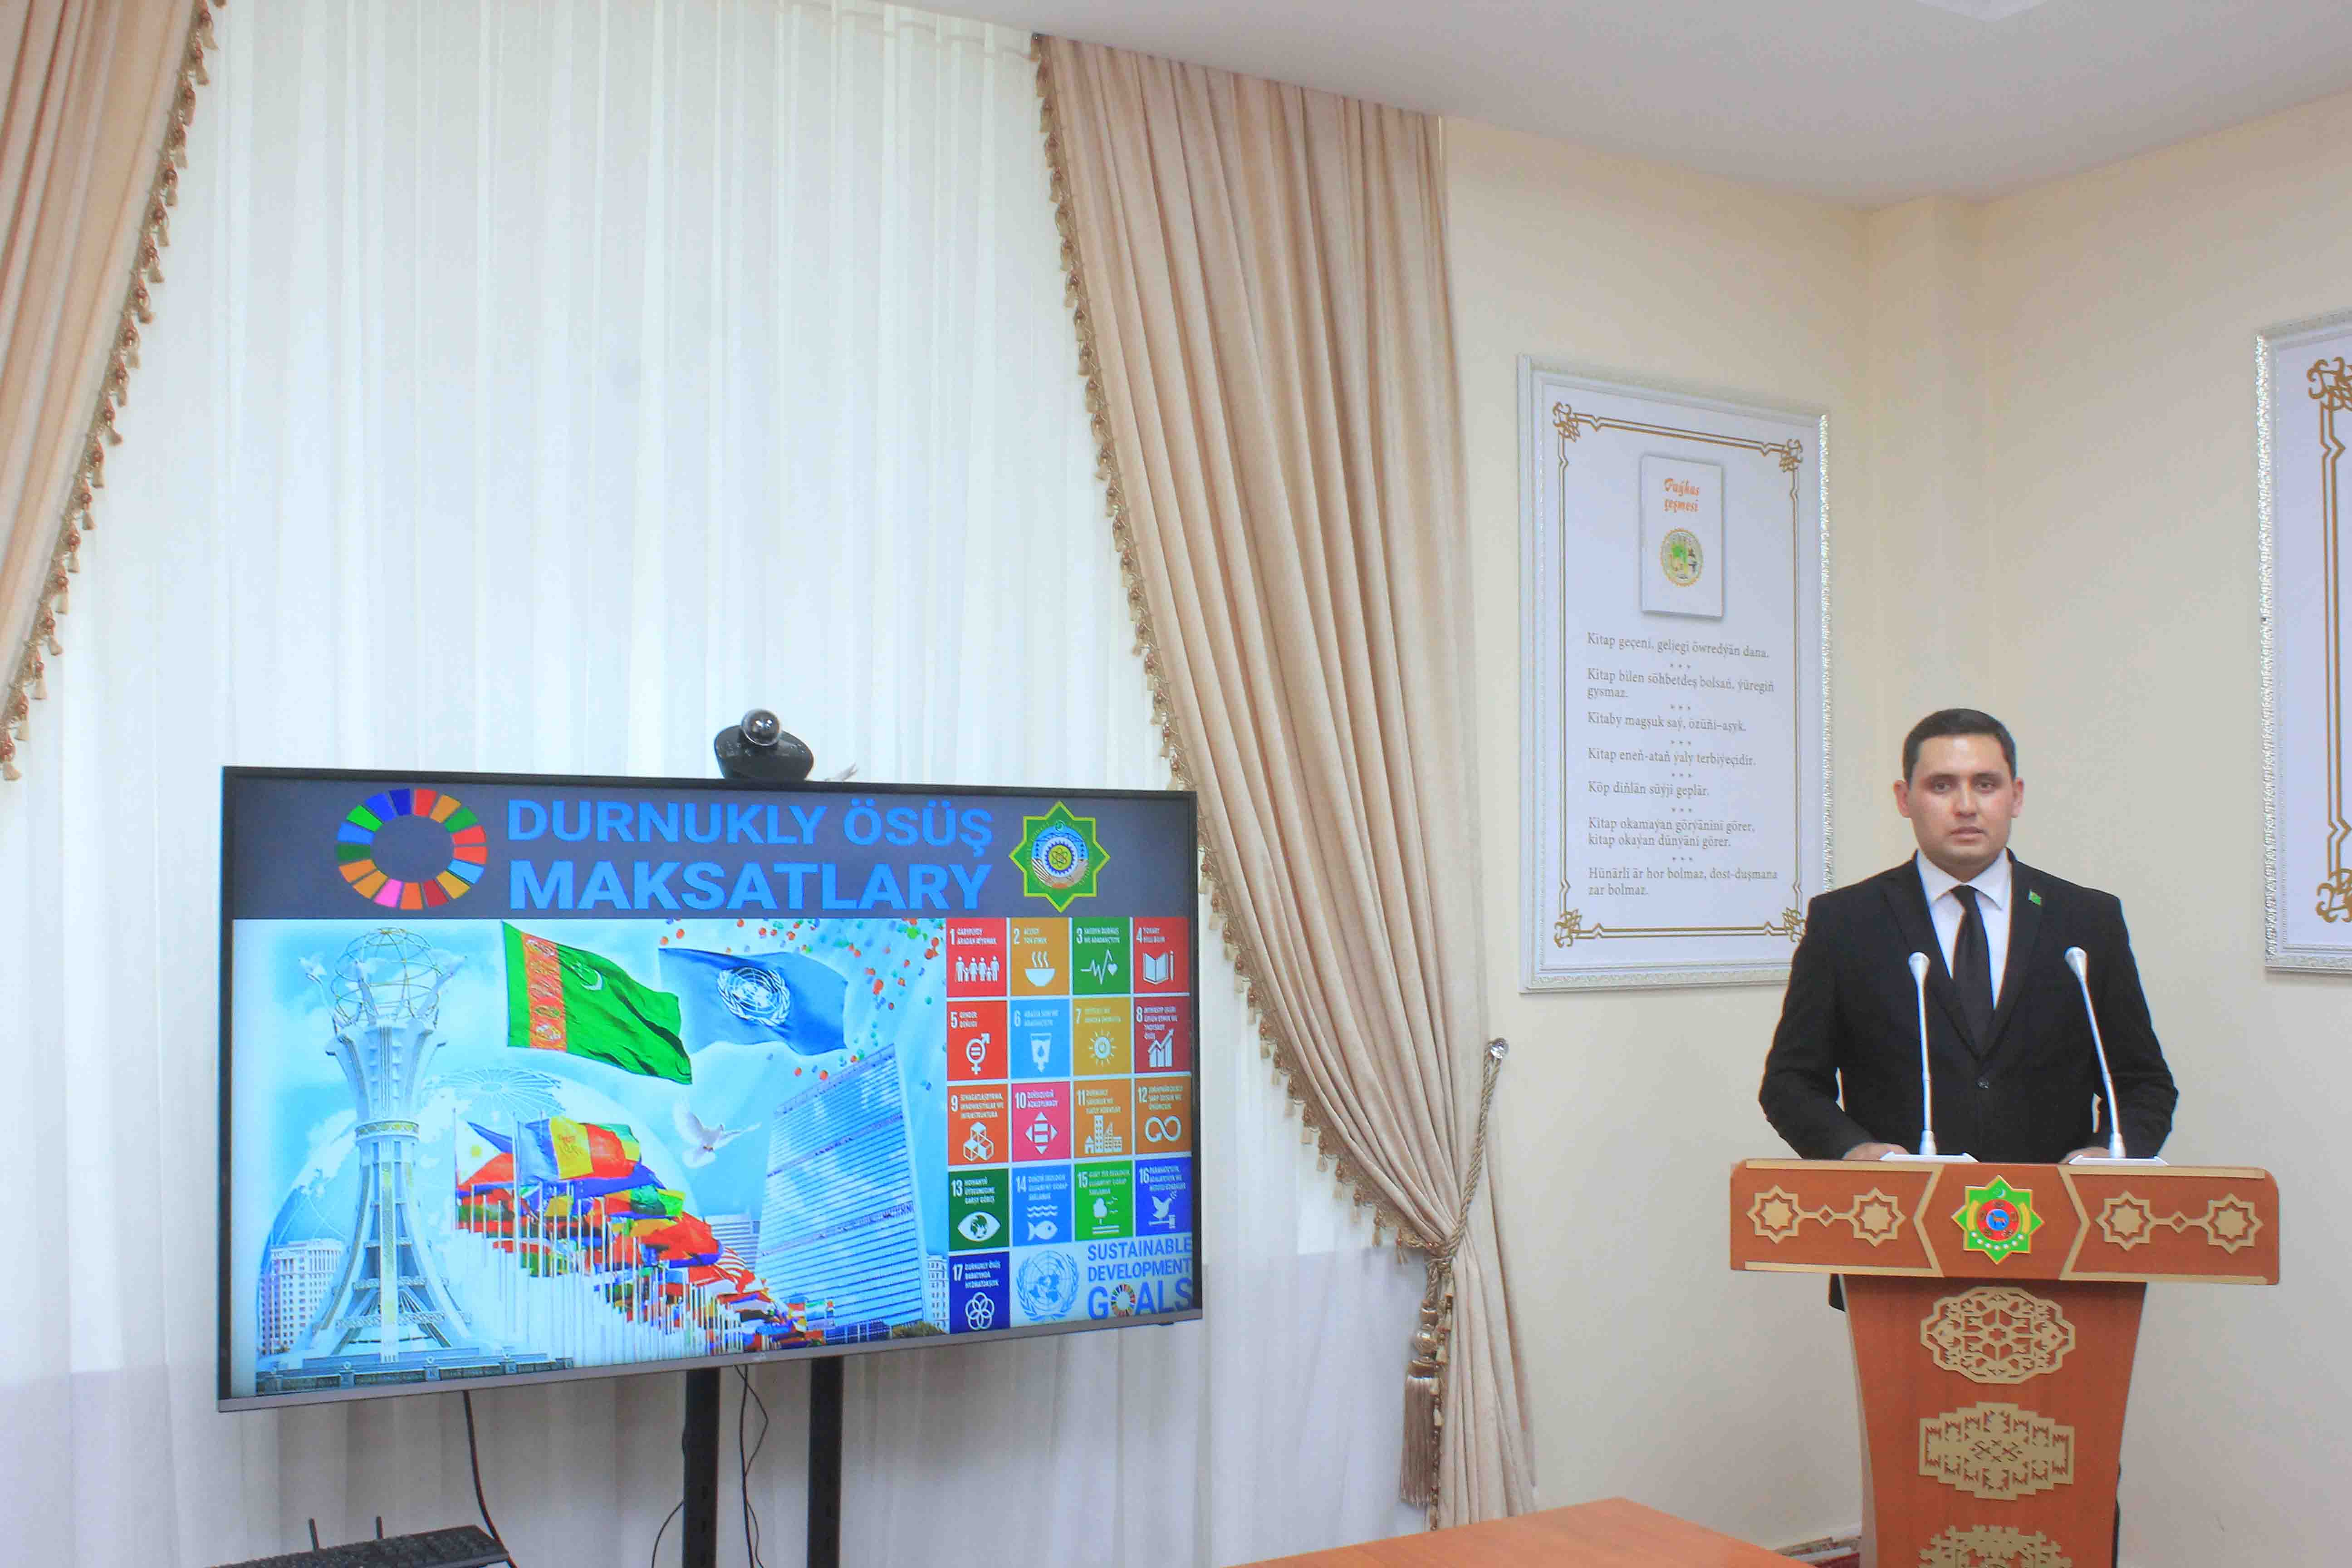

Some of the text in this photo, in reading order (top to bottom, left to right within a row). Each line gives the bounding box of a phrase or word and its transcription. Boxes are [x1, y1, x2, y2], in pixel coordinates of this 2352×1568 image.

[1587, 632, 1615, 649] Kitap
[1742, 645, 1769, 657] dana.
[1587, 668, 1615, 684] Kitap
[1618, 669, 1645, 682] bilen
[1587, 687, 1629, 699] gysmaz.
[1587, 711, 1622, 728] Kitaby
[1588, 747, 1617, 763] Kitap
[1588, 781, 1610, 796] Köp
[1676, 784, 1710, 799] geplär.
[508, 798, 994, 858] DURNUKLY ÖSÜŞ
[1588, 817, 1617, 832] Kitap
[1588, 833, 1615, 849] kitap
[1702, 836, 1732, 850] görer.
[1588, 867, 1631, 879] Hünärli
[1633, 868, 1643, 879] är
[1646, 867, 1664, 879] hor
[509, 860, 993, 911] MAKSATLARY
[1588, 883, 1649, 896] zar bolmaz.
[950, 928, 956, 945] 1
[1014, 928, 1020, 944] 2
[1076, 928, 1083, 944] 3
[1136, 927, 1143, 943] 4
[951, 1011, 958, 1029] 5
[1014, 1010, 1021, 1027] 6
[1076, 1009, 1082, 1024] 7
[1136, 1006, 1143, 1023] 8
[951, 1094, 959, 1112] 9
[1015, 1092, 1026, 1109] 10
[1077, 1089, 1086, 1106] 11
[1138, 1086, 1148, 1103] 12
[1016, 1176, 1027, 1193] 14
[1078, 1171, 1088, 1188] 15
[1139, 1167, 1149, 1185] 16
[951, 1180, 963, 1197] 13
[1088, 1236, 1191, 1261] SUSTAINABLE
[953, 1264, 963, 1281] 17
[1088, 1258, 1191, 1282] DEVELOPMENT
[1088, 1277, 1192, 1319] GOALS
